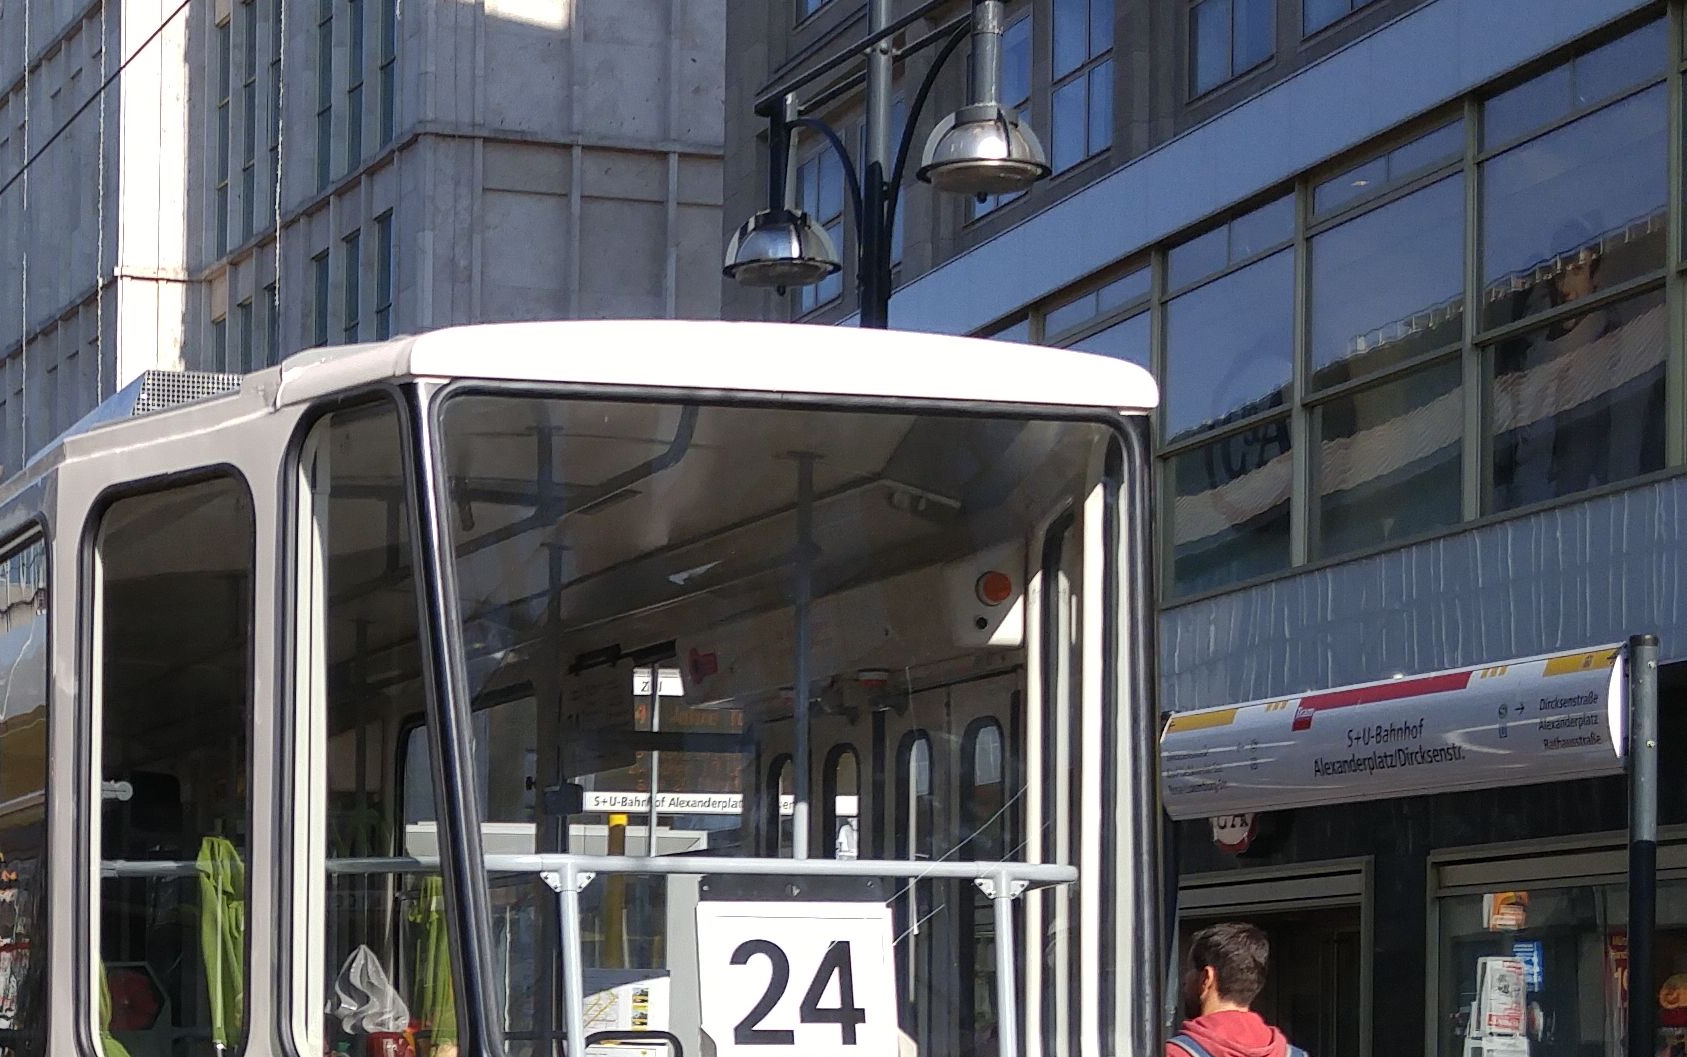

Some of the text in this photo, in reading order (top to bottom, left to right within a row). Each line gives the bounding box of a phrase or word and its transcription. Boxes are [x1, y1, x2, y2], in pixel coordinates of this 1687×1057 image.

[1347, 718, 1425, 748] S+U-Bahnhof
[1538, 712, 1599, 731] Alexanderplatz
[1314, 743, 1466, 777] Alexanderplatz/Dircksenstr.
[729, 939, 866, 1045] 24
